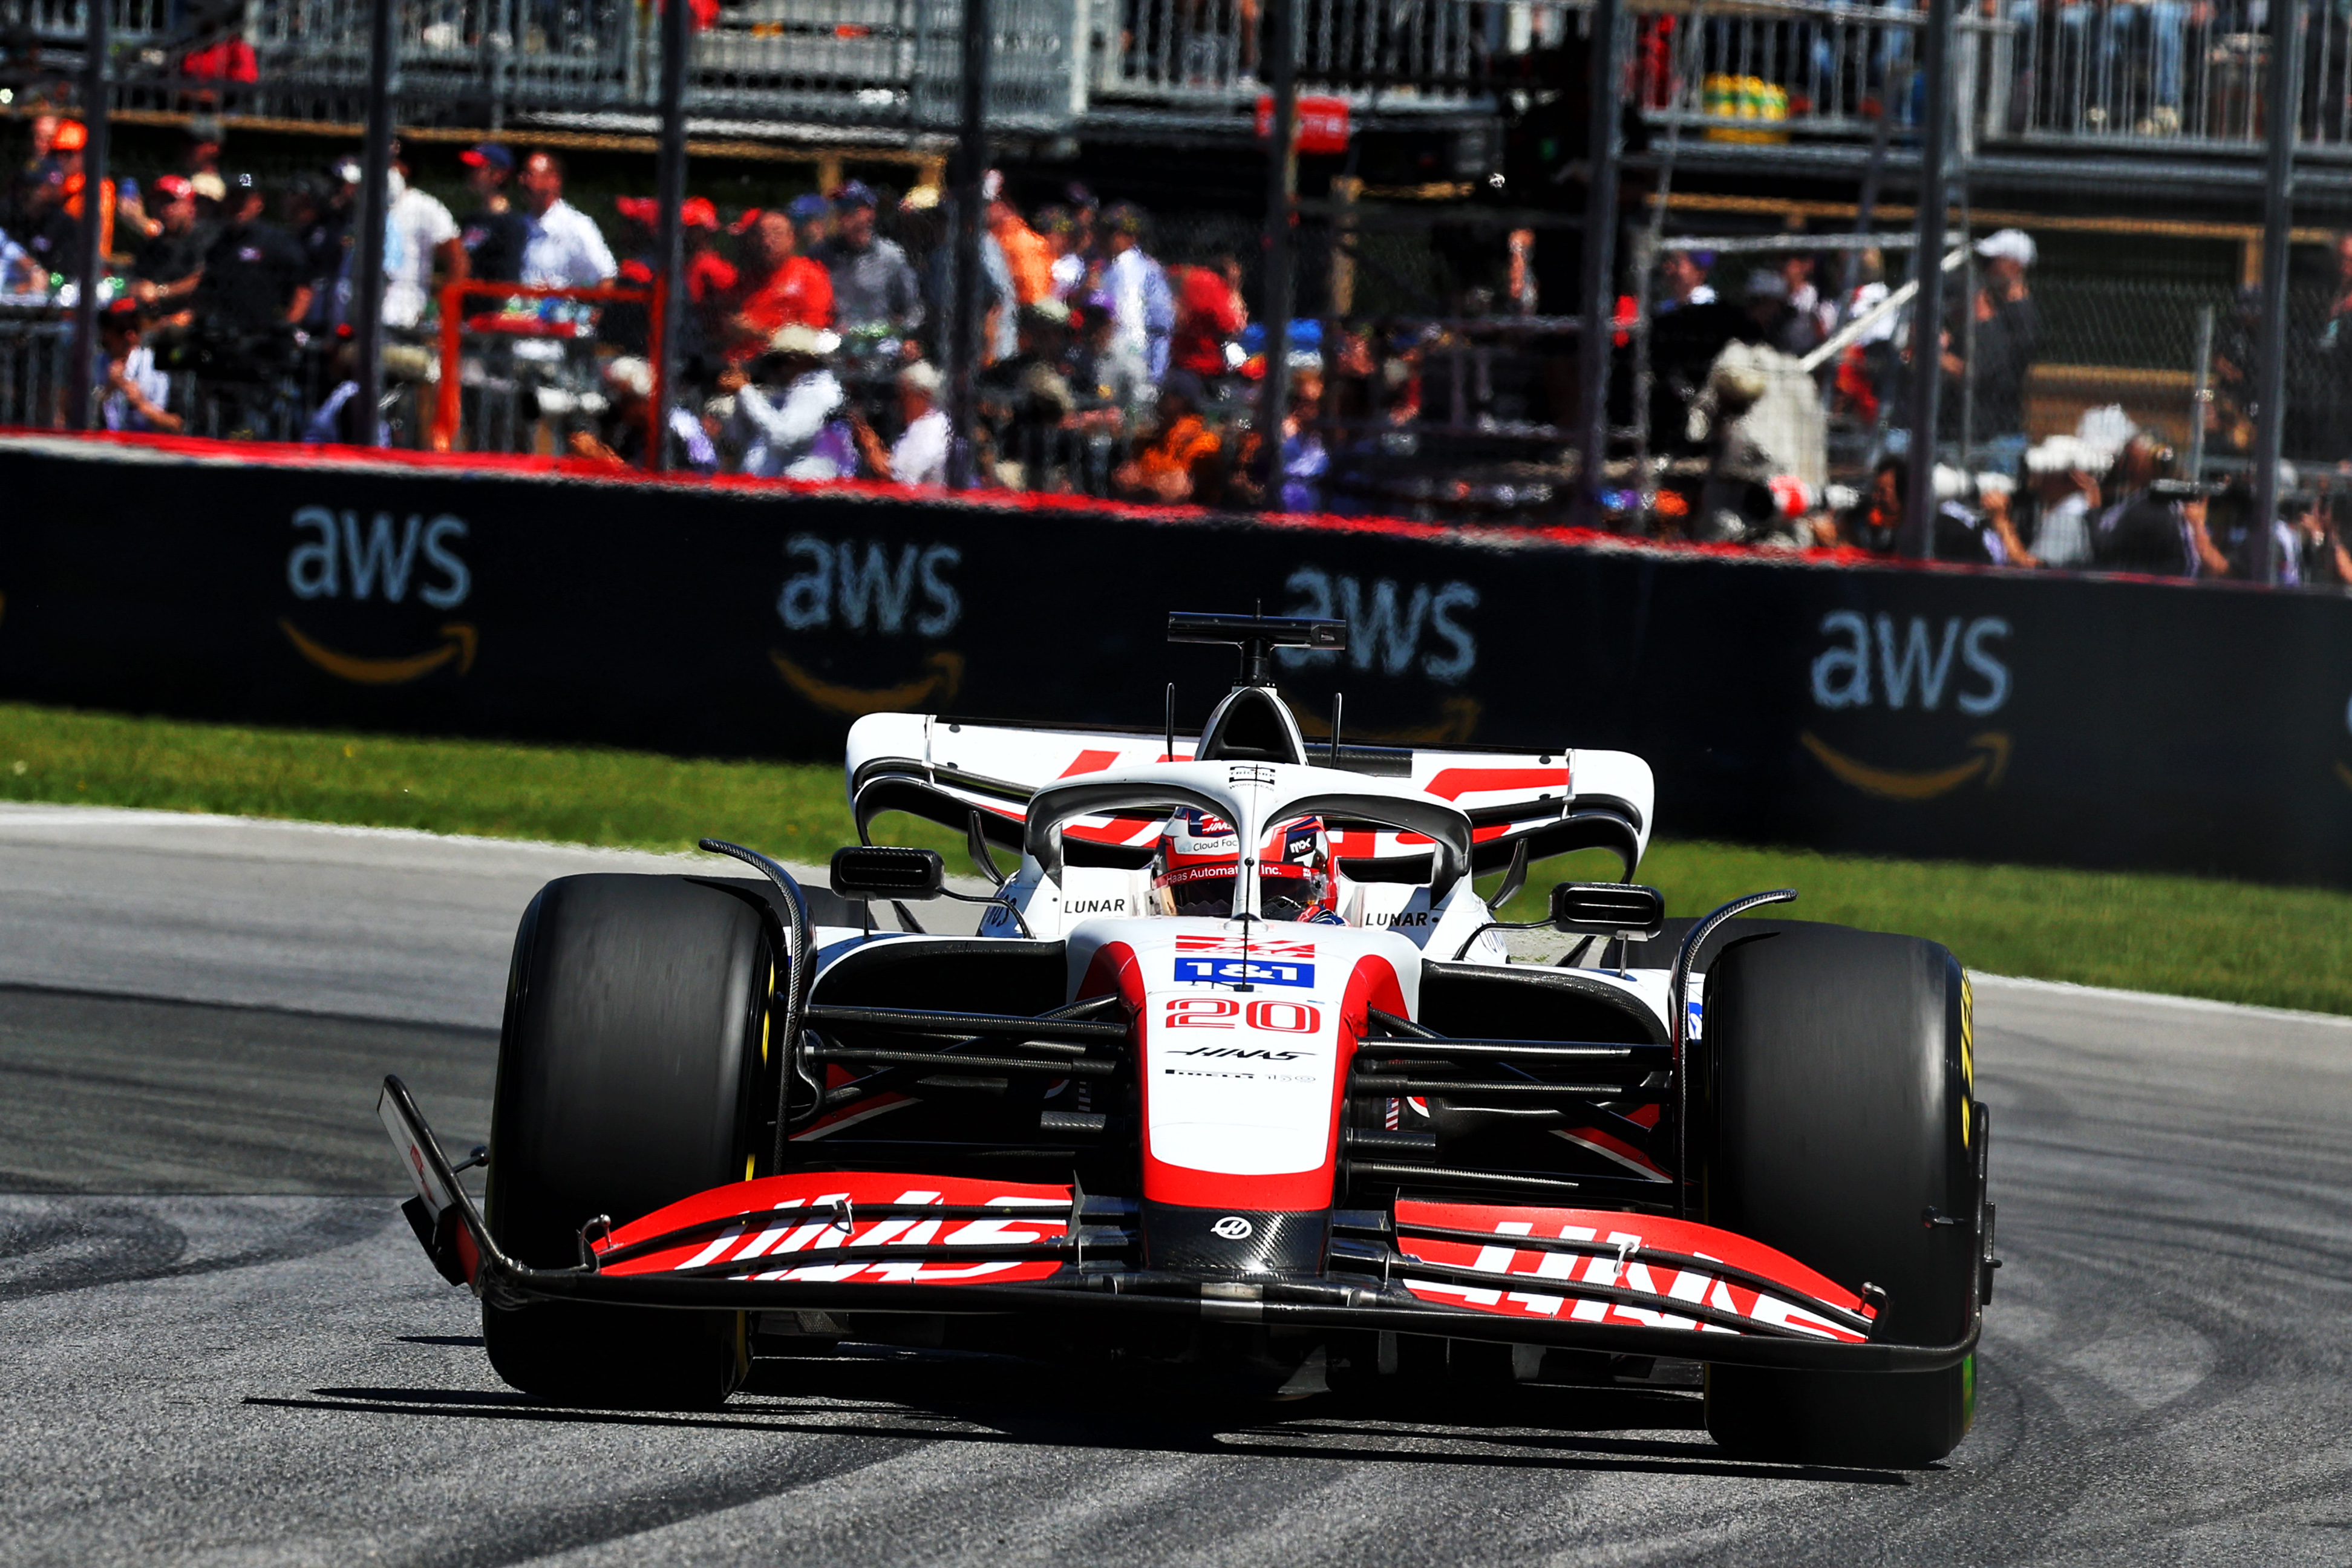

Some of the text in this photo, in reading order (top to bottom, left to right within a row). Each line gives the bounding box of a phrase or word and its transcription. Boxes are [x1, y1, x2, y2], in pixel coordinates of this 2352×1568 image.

[286, 505, 471, 609] aws
[777, 534, 962, 638] aws
[1275, 567, 1480, 684] aws
[1811, 609, 2013, 715] aws
[1229, 783, 1275, 792] WORKWEAR
[1193, 840, 1219, 851] Cloud
[1166, 872, 1187, 885] Haas
[1261, 864, 1282, 875] Inc.
[1063, 898, 1125, 913] LUNAR
[1365, 912, 1428, 926] LUNAR
[1186, 962, 1298, 981] 1&1
[1165, 998, 1321, 1034] 20
[1164, 1047, 1318, 1060] HAAS
